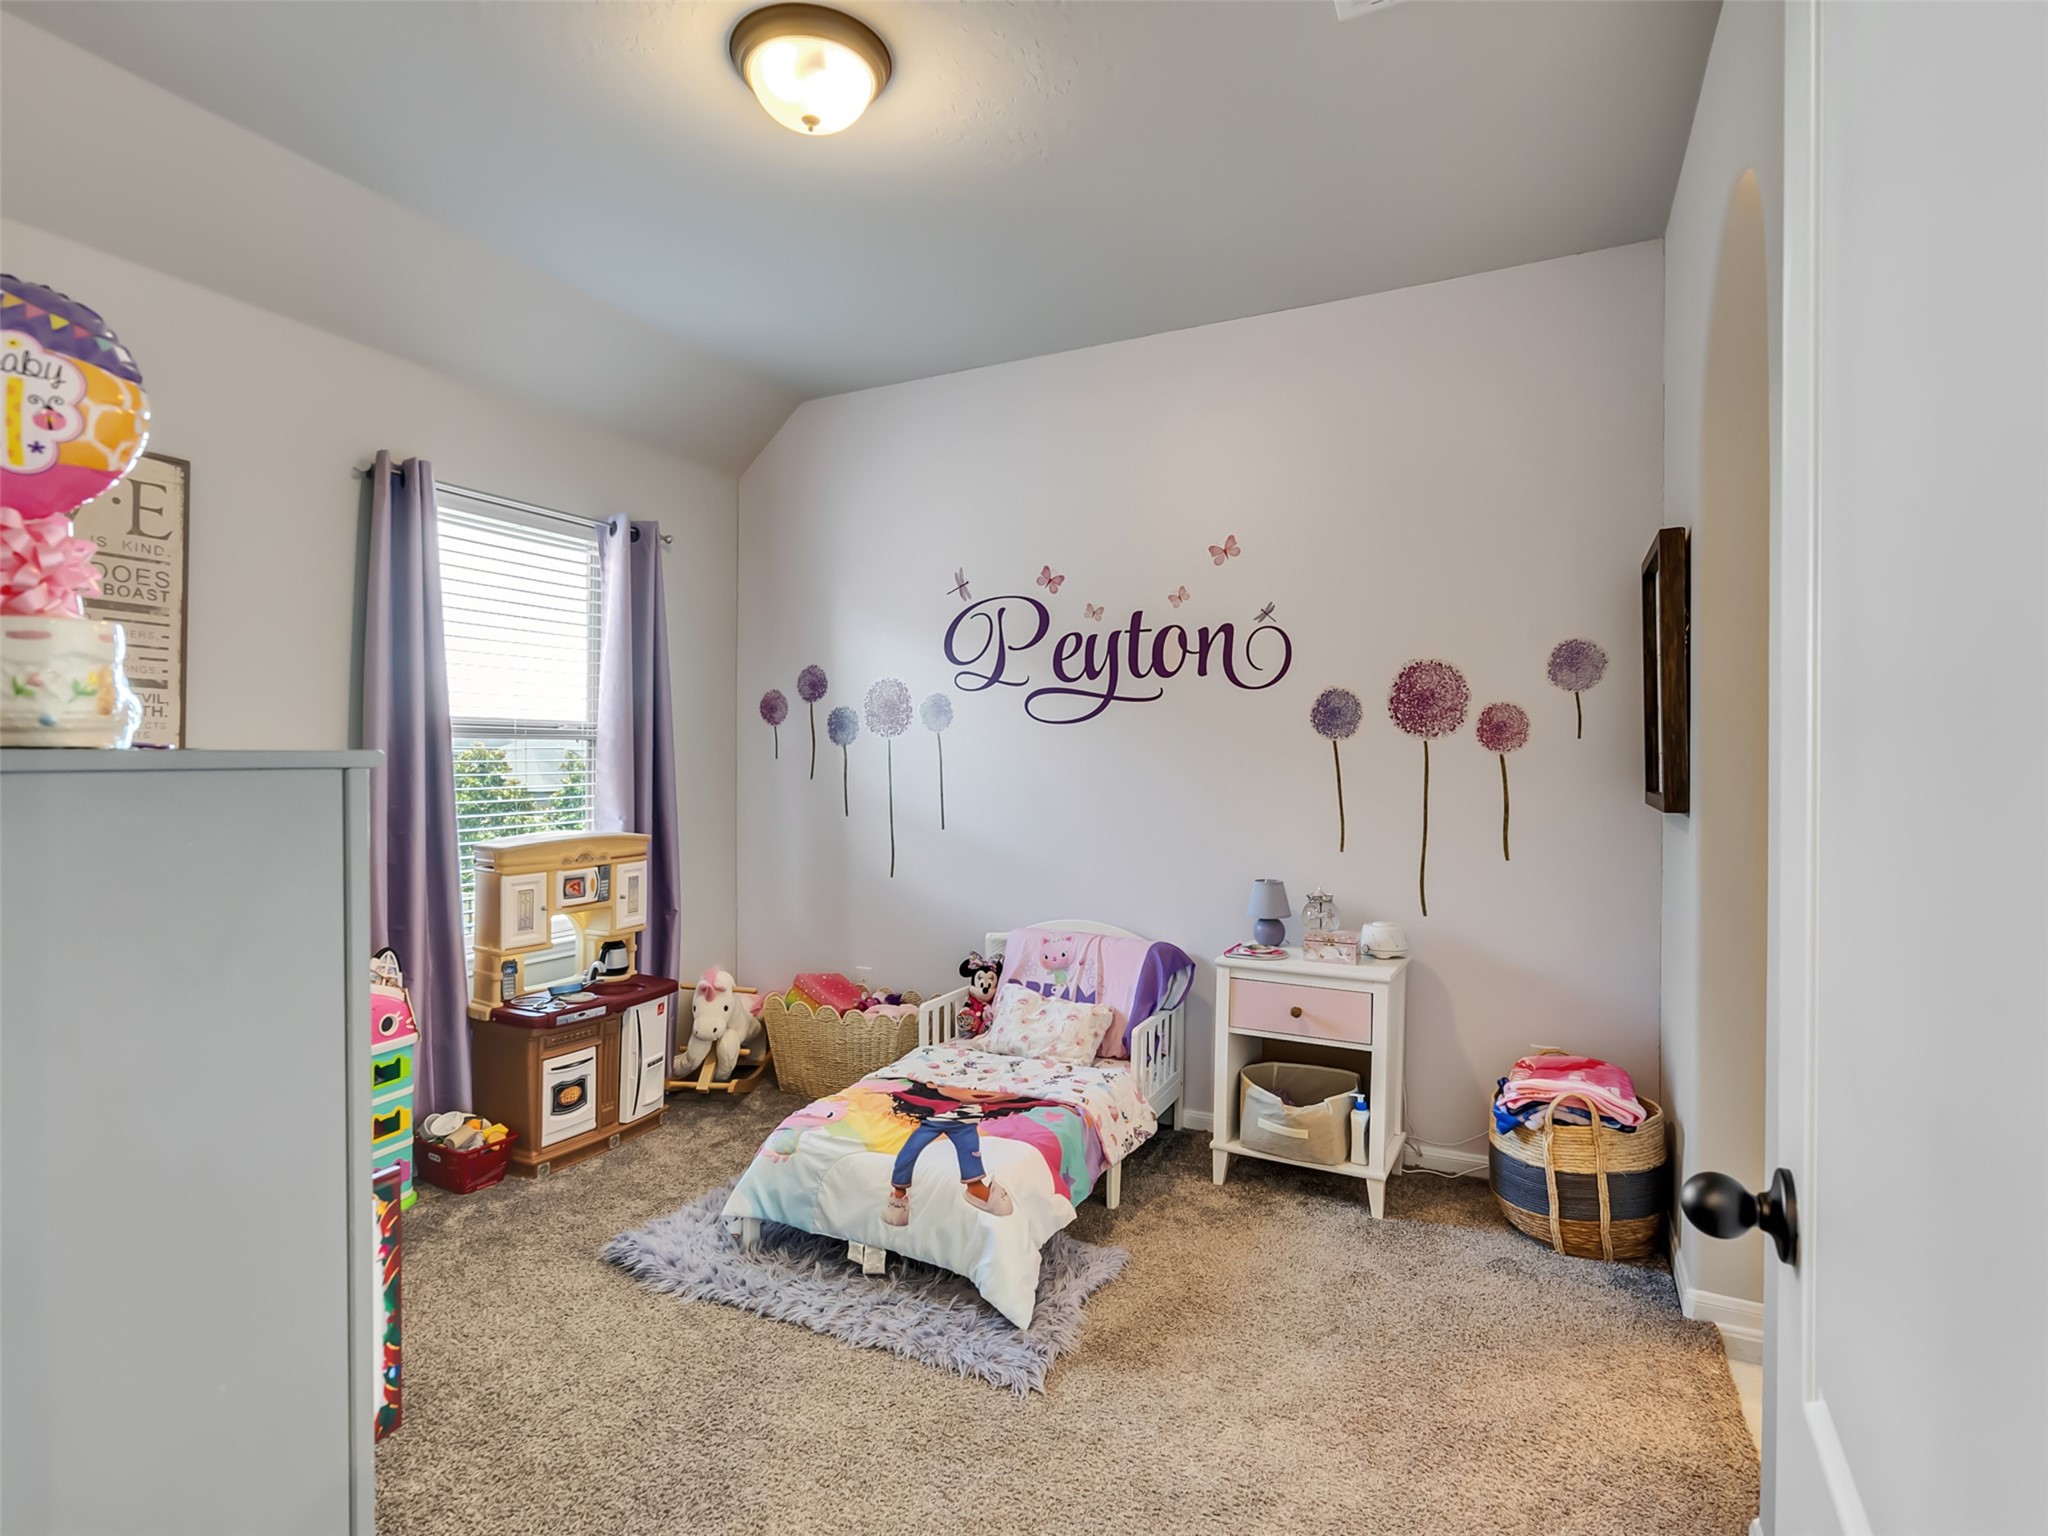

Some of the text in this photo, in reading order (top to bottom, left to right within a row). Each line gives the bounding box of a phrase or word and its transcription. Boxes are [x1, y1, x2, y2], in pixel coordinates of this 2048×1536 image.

[0, 350, 66, 389] aby
[121, 540, 171, 558] KIND.
[103, 583, 171, 602] BOAST
[126, 629, 160, 641] ERS.
[944, 595, 1292, 724] Peyton
[142, 705, 169, 718] TH.
